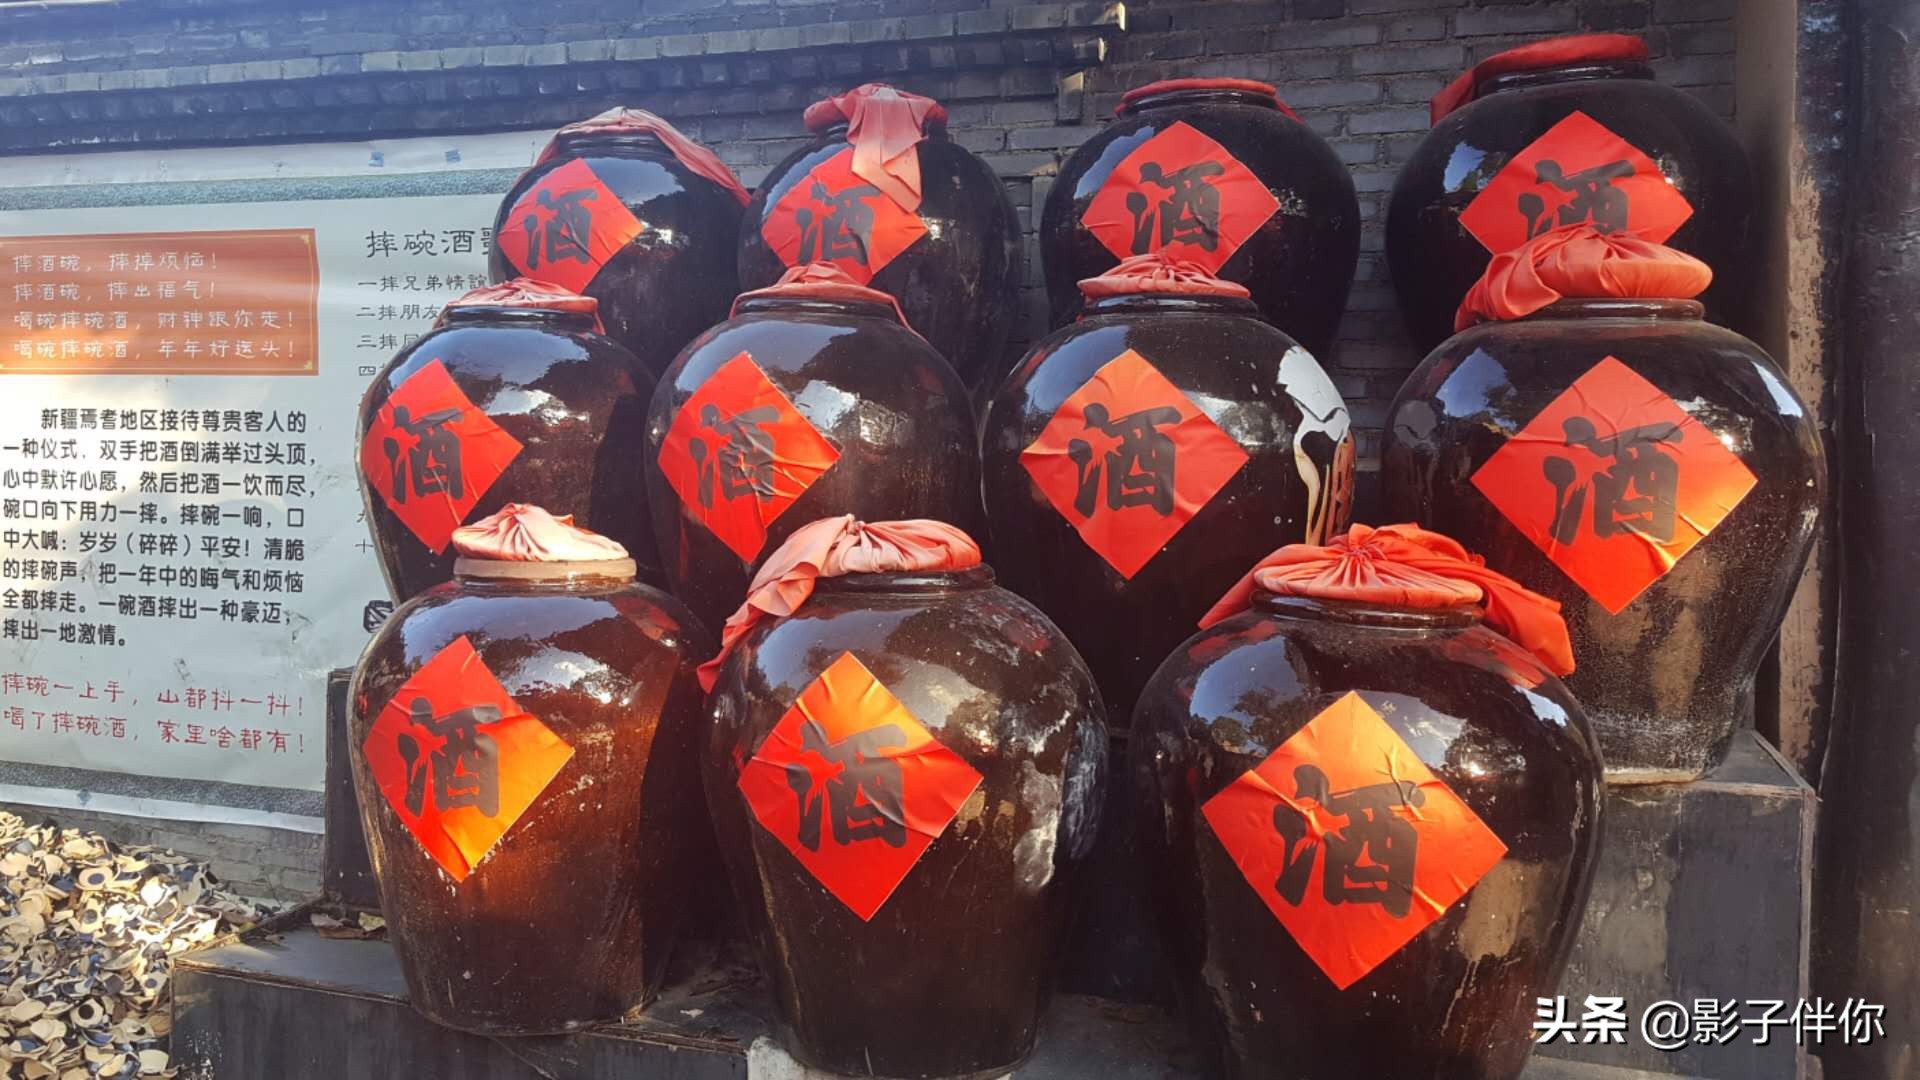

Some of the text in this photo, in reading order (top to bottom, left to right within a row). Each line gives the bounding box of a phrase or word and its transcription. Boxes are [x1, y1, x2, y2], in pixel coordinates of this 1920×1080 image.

[524, 189, 597, 270] 酒
[795, 182, 881, 266] 酒
[1126, 161, 1225, 255] 酒
[41, 408, 307, 433] 新疆焉耆地区接待尊贵客人的
[384, 405, 464, 504] 酒
[689, 403, 782, 509] 酒
[1068, 401, 1182, 519] 酒
[1543, 416, 1685, 546] 酒
[2, 618, 127, 647] 摔出一地激情。
[399, 697, 504, 819] 酒
[785, 720, 908, 852] 酒
[1273, 764, 1426, 919] 酒
